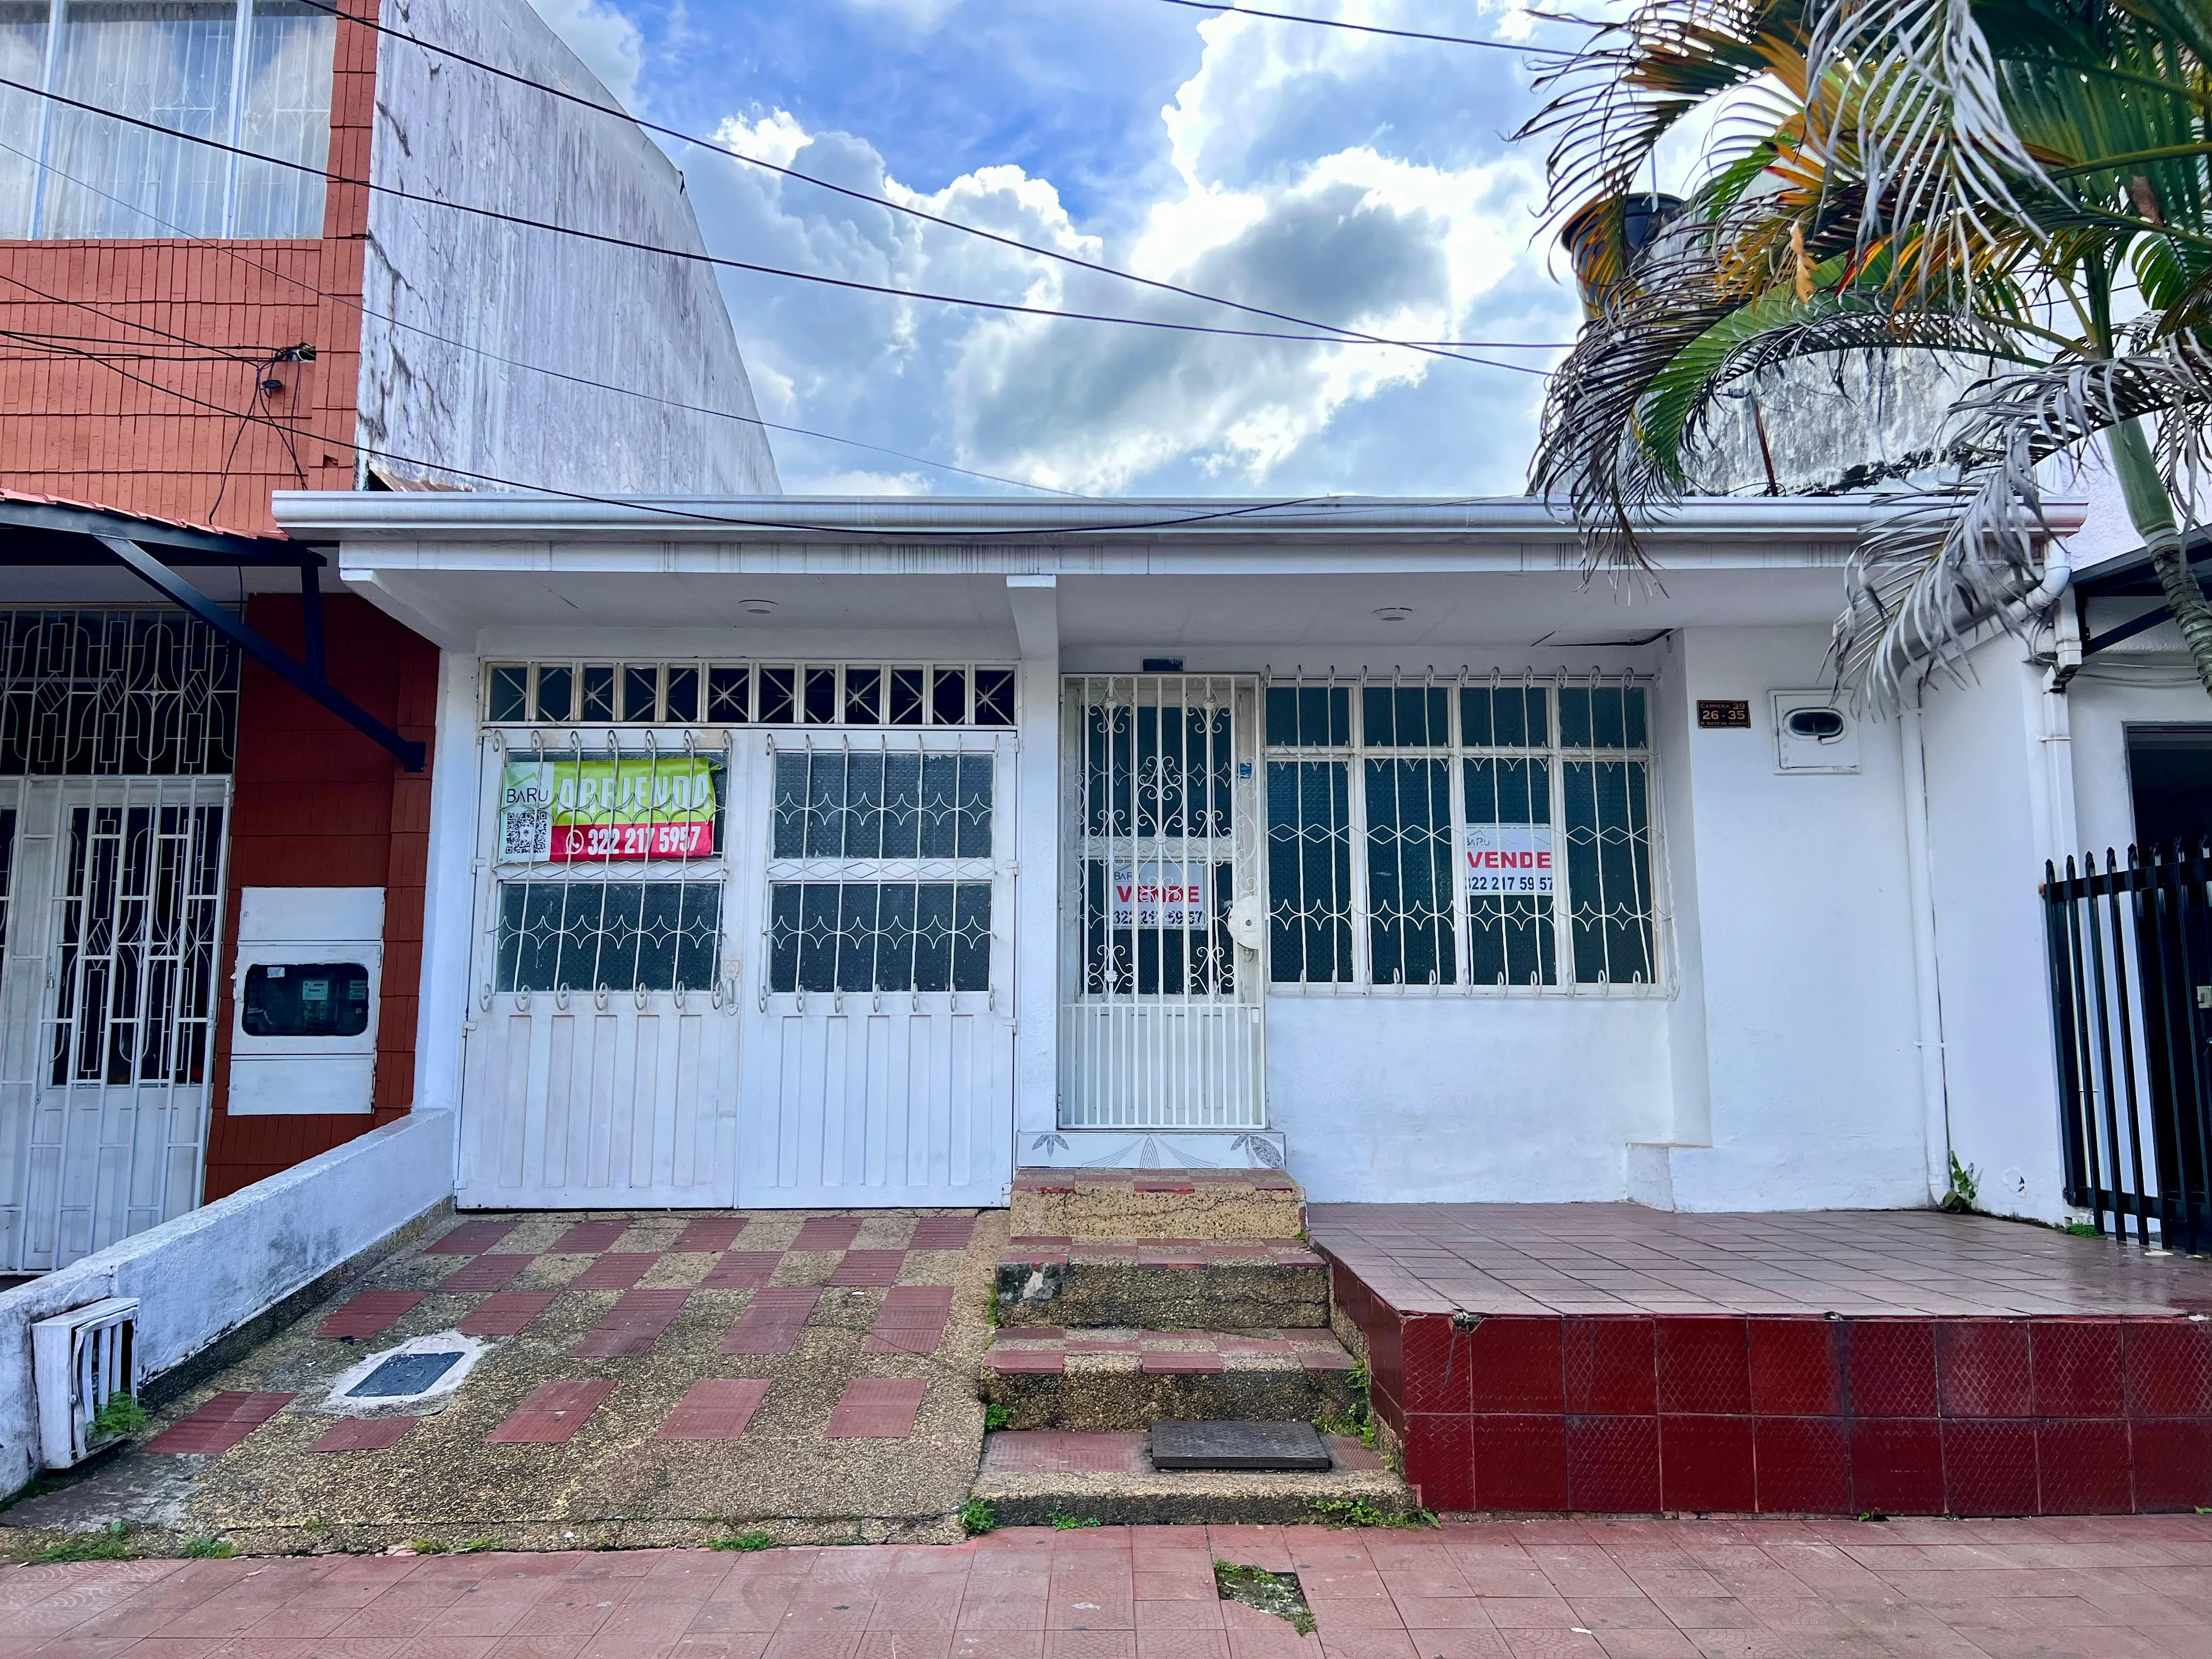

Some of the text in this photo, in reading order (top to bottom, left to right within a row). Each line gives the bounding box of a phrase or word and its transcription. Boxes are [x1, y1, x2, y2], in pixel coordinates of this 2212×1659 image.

[1702, 710, 1719, 720] 26
[1728, 710, 1745, 720] 35
[506, 787, 549, 803] BARU
[556, 774, 710, 814] ARRIENDA
[588, 826, 701, 855] 322 217 5957
[1467, 851, 1552, 868] VENDE
[1492, 877, 1515, 890] 217
[1520, 877, 1534, 890] 59
[1116, 885, 1200, 902] VENDE
[1140, 911, 1159, 924] 21
